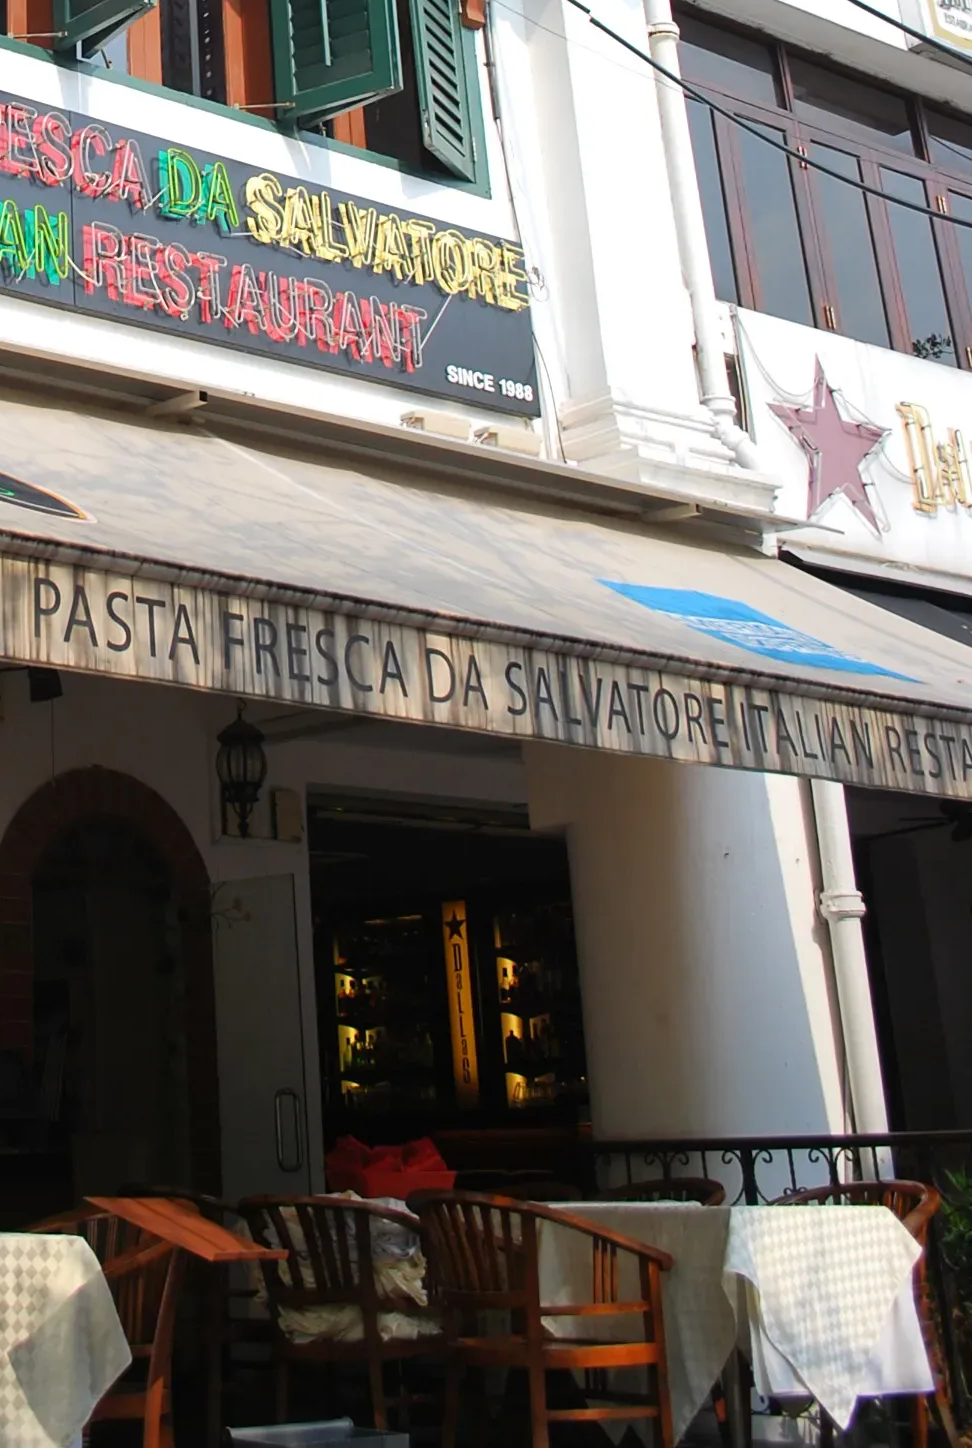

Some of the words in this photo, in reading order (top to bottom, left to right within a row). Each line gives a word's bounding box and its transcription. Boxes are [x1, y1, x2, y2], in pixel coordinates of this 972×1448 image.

[82, 221, 428, 373] RESTAURANT
[158, 148, 239, 233] DA
[244, 173, 532, 312] SALVATORE
[446, 365, 495, 393] SINCE
[498, 379, 533, 402] 1988
[34, 577, 201, 666] PASTA
[222, 611, 408, 698] FRESCA
[425, 647, 489, 711] DA
[504, 661, 730, 748] SALVATORE
[739, 702, 875, 769] ITALIAN
